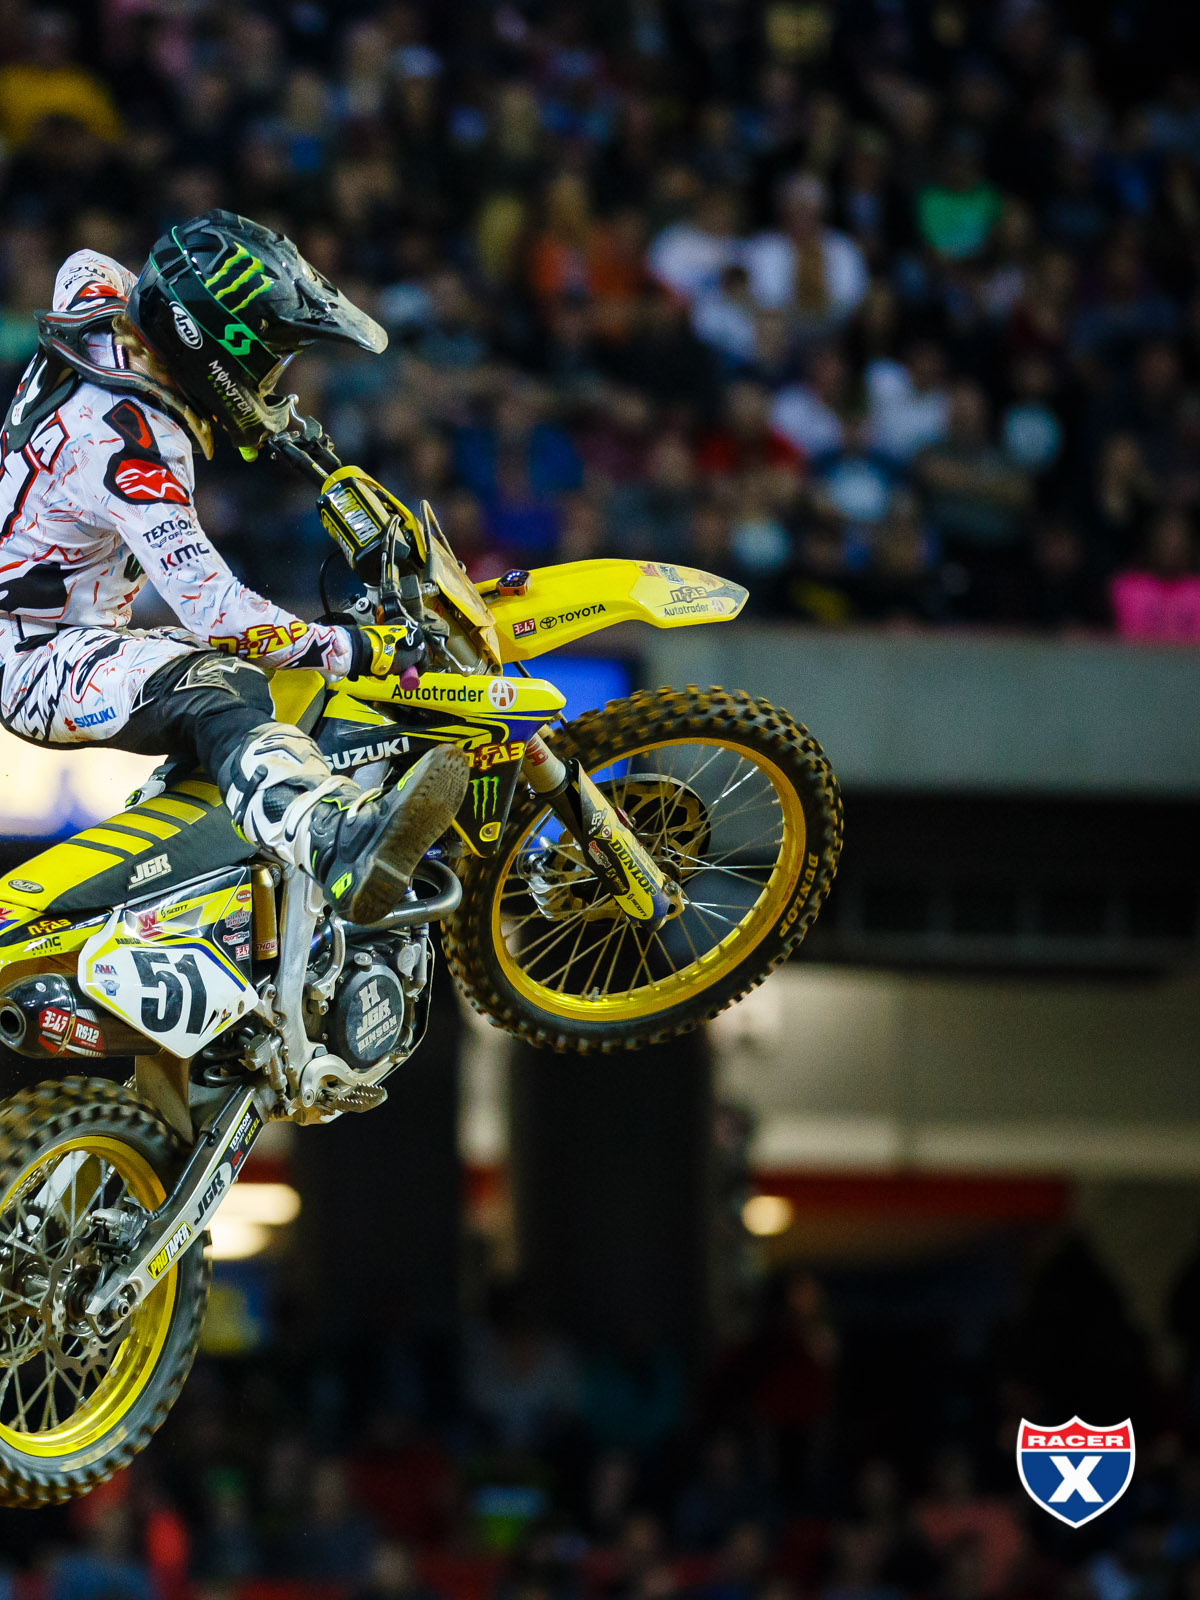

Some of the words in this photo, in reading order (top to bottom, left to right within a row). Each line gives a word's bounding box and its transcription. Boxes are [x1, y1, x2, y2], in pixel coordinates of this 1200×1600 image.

[174, 312, 198, 341] Arai
[558, 604, 606, 623] TOYOTA
[663, 605, 709, 617] Autotrader
[391, 684, 484, 702] Autotrader
[74, 706, 117, 728] SUZUKI
[129, 853, 172, 884] JGR
[609, 840, 657, 897] DUNLOP
[779, 851, 819, 937] DUNLOP
[95, 964, 117, 975] AMA
[130, 951, 207, 1034] 51
[356, 998, 391, 1039] JGR
[357, 1015, 398, 1054] HINSON
[229, 1112, 251, 1149] TEXTRON
[244, 1118, 260, 1145] EXCEL
[194, 1170, 225, 1226] JGR
[150, 1223, 189, 1277] PROTAPER
